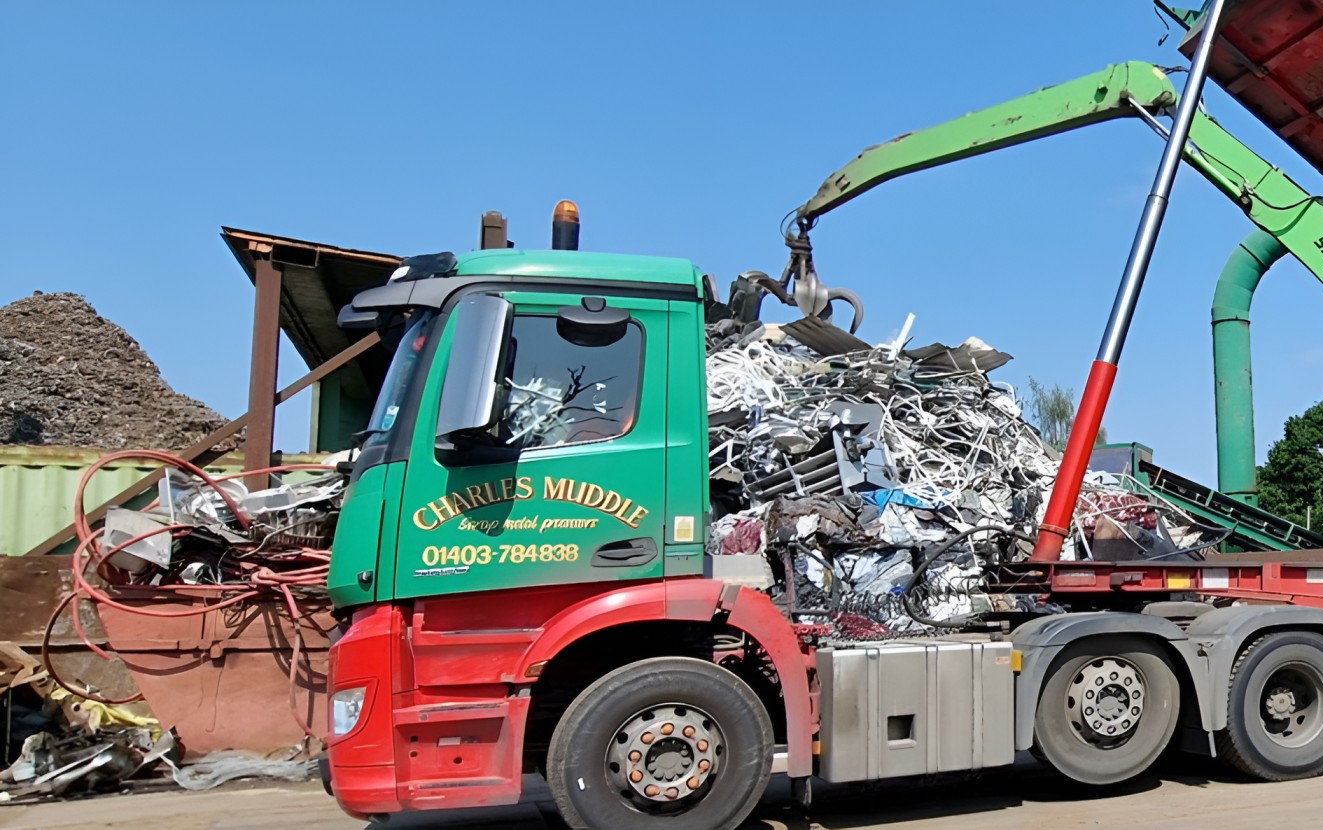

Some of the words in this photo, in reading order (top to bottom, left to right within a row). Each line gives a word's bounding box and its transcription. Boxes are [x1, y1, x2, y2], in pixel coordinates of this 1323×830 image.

[412, 477, 534, 531] CHARLES
[543, 476, 649, 529] MUDDLE
[422, 544, 579, 566] 01403-784838
